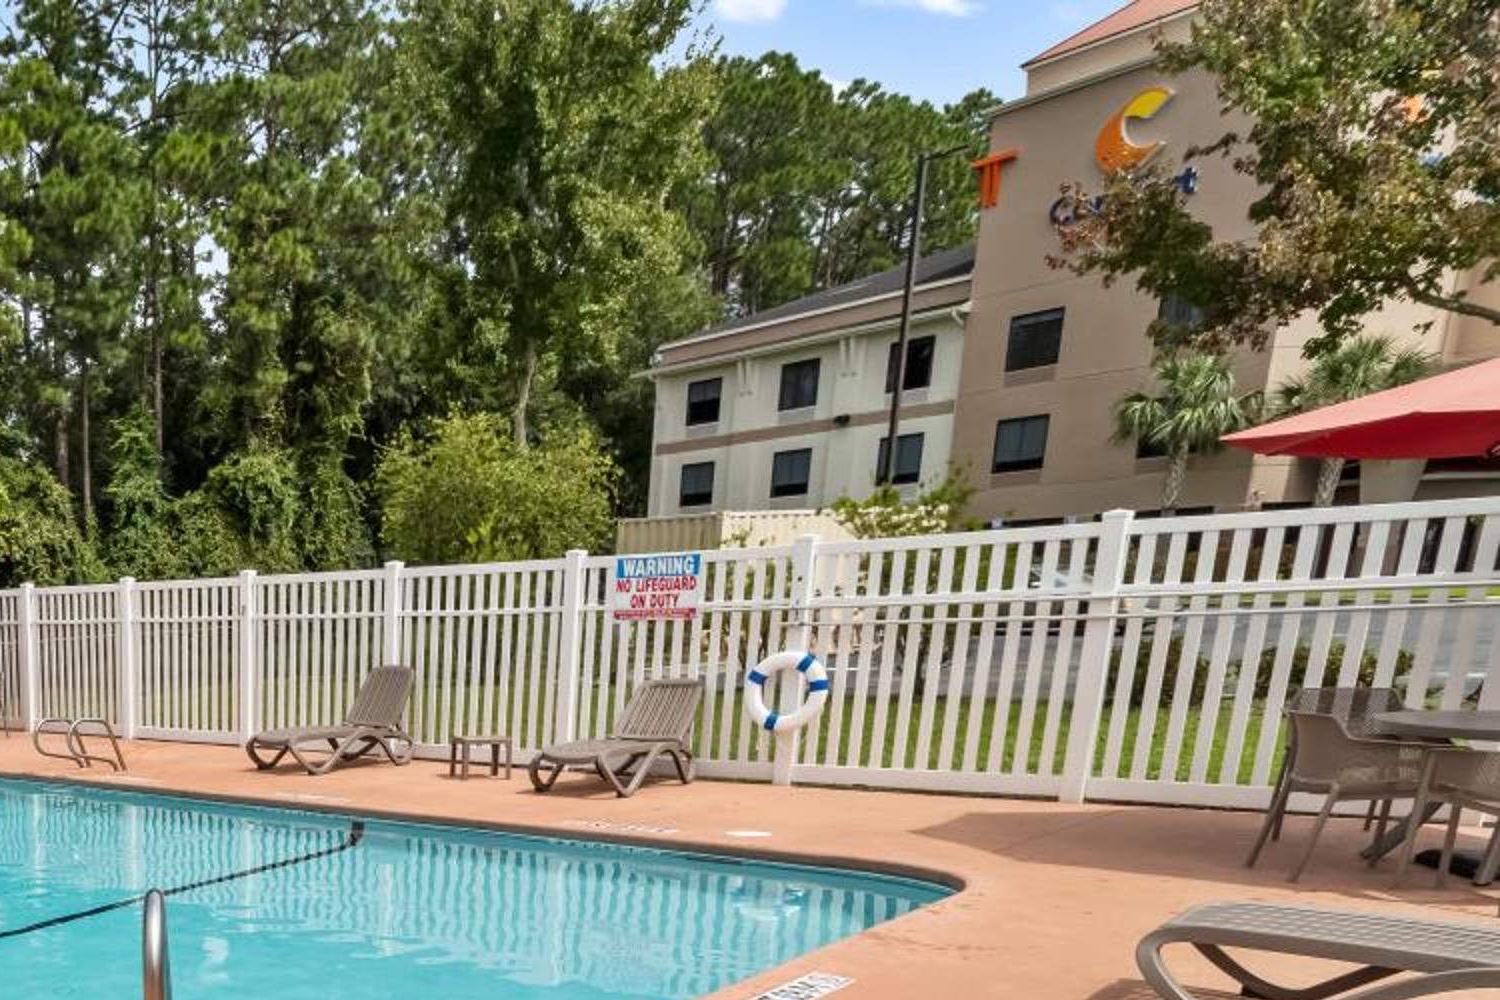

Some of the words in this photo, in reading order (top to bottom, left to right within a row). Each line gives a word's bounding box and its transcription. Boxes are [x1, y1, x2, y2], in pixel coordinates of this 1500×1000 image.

[623, 556, 694, 577] WARNING
[615, 579, 631, 592] NO
[636, 576, 697, 592] LIFEGUARD
[630, 594, 645, 608] ON
[649, 593, 679, 608] DUTY
